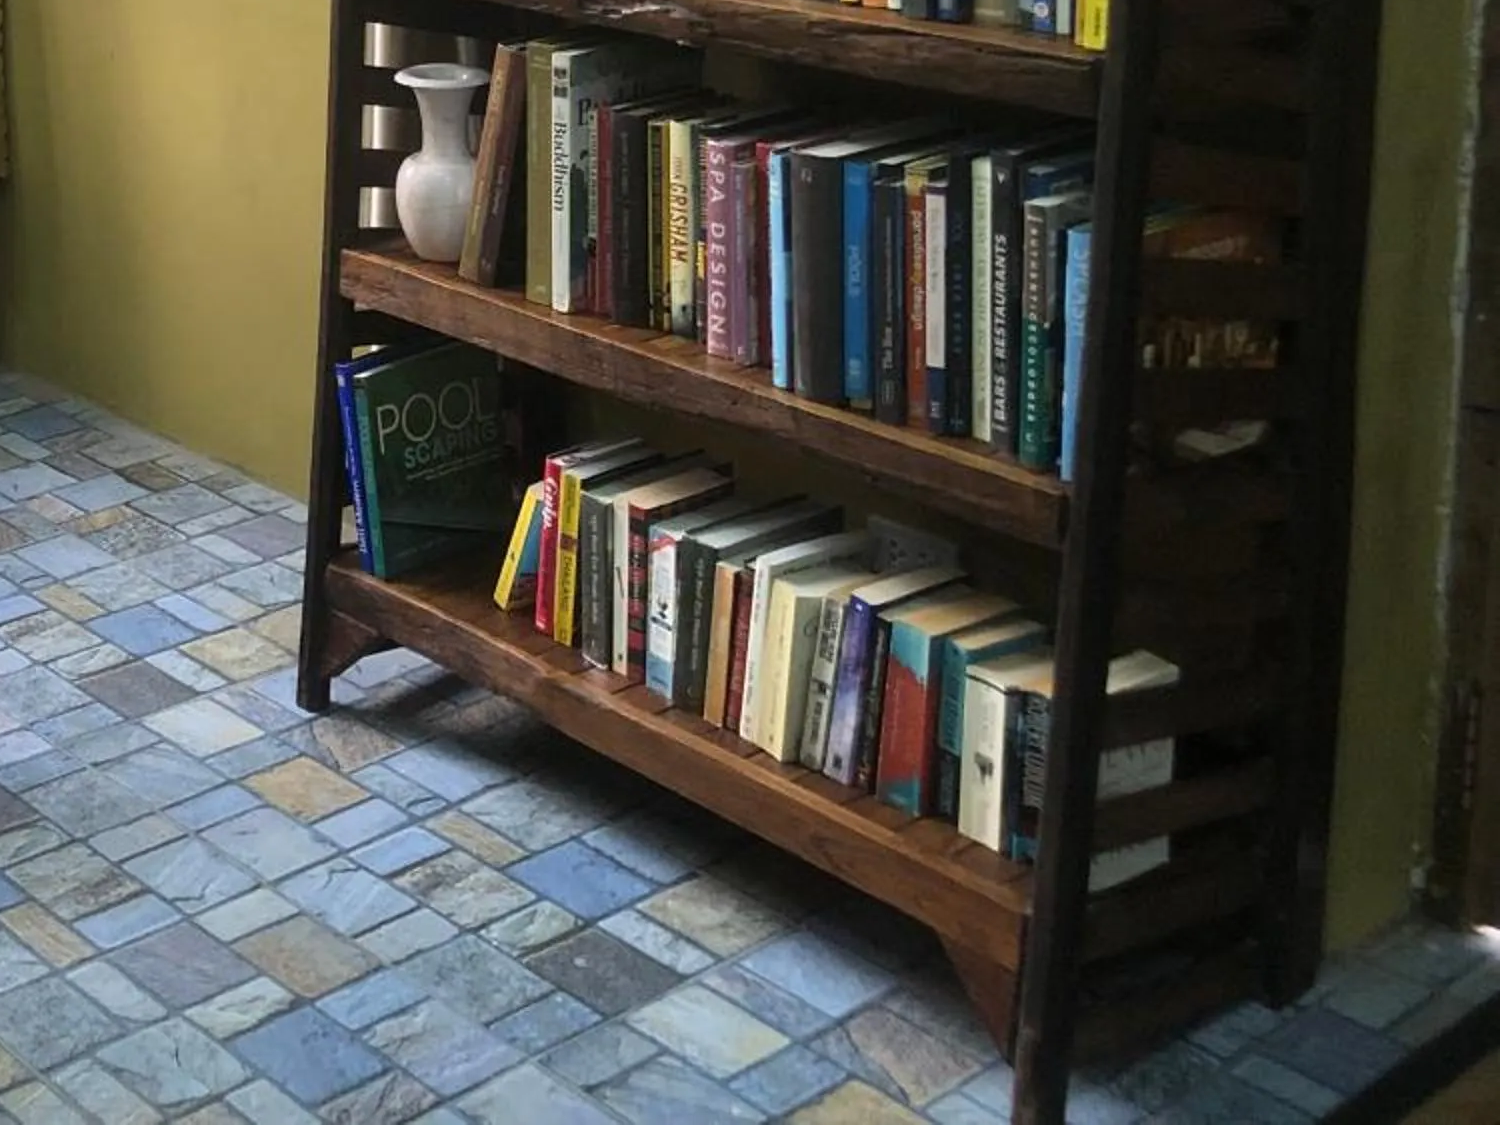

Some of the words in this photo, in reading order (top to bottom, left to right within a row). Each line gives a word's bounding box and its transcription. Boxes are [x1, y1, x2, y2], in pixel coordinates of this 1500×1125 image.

[552, 121, 570, 213] Buddhism
[709, 151, 727, 204] SPA
[670, 182, 689, 268] GRISHAM
[909, 209, 926, 270] paradise
[709, 221, 727, 335] DESIGN
[909, 285, 928, 330] design
[992, 234, 1009, 360] RESTAURANTS
[376, 377, 497, 456] POOL
[991, 376, 1008, 424] BARS
[403, 421, 499, 471] SCAPING
